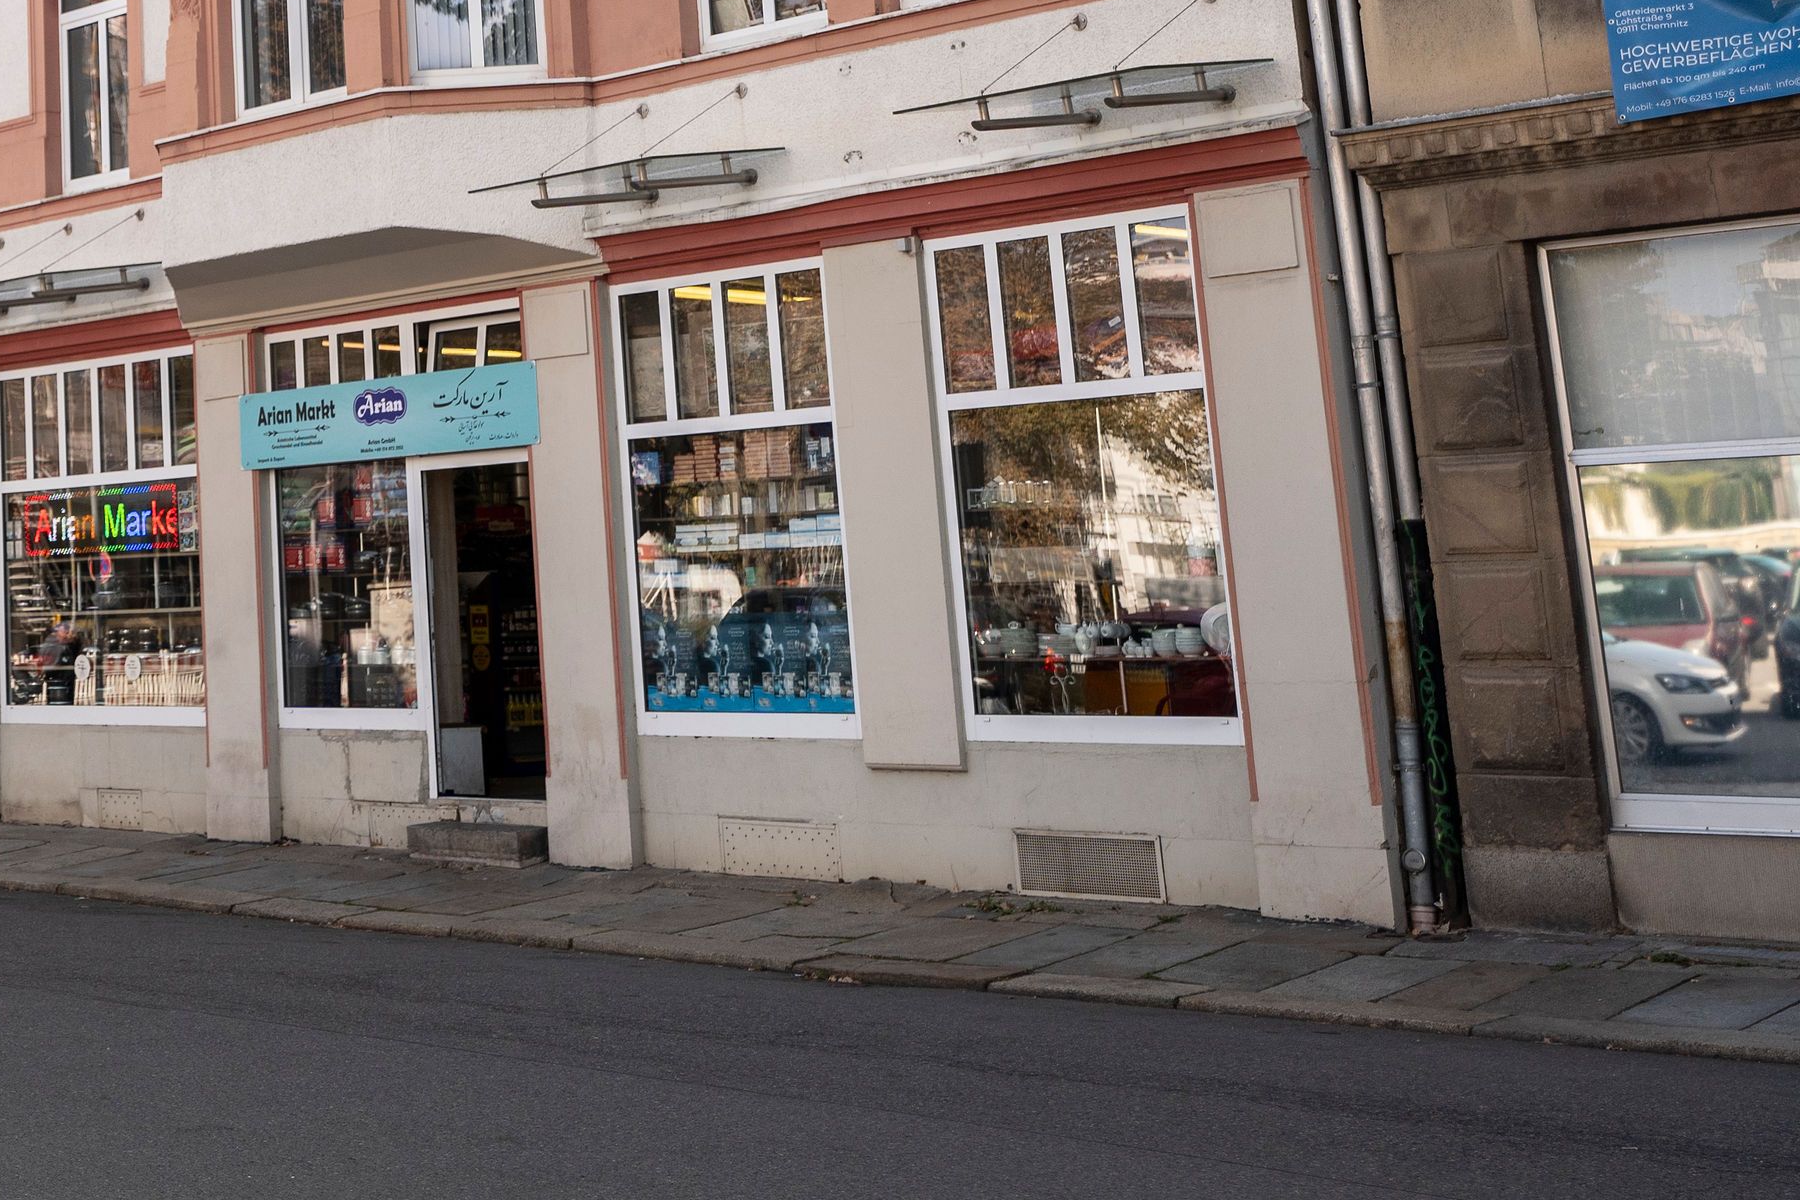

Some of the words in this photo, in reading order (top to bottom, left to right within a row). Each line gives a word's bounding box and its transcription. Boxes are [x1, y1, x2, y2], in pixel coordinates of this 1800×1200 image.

[1615, 4, 1686, 18] Getreidemarkt
[1688, 2, 1694, 10] 3
[1616, 14, 1664, 26] Lohstraße
[1666, 13, 1672, 21] 9
[1640, 20, 1689, 30] Chemnitz
[1620, 33, 1753, 60] HOCHWERTIGE
[1622, 39, 1792, 75] GEWERBEFLÄCHEN
[1624, 79, 1658, 91] Flächen
[1660, 76, 1673, 84] ab
[1675, 75, 1691, 83] 100
[1693, 73, 1710, 83] qm
[1712, 69, 1726, 78] bis
[1728, 66, 1747, 75] 240
[1748, 63, 1766, 73] qm
[1626, 102, 1653, 113] Mobil:
[1655, 99, 1671, 108] +49
[1672, 96, 1687, 105] 176
[1715, 88, 1735, 99] 1526
[1739, 82, 1771, 95] E-Mail:
[257, 406, 293, 427] Arian
[295, 399, 336, 422] Markt
[357, 394, 403, 418] Arian
[34, 508, 96, 543] Arian
